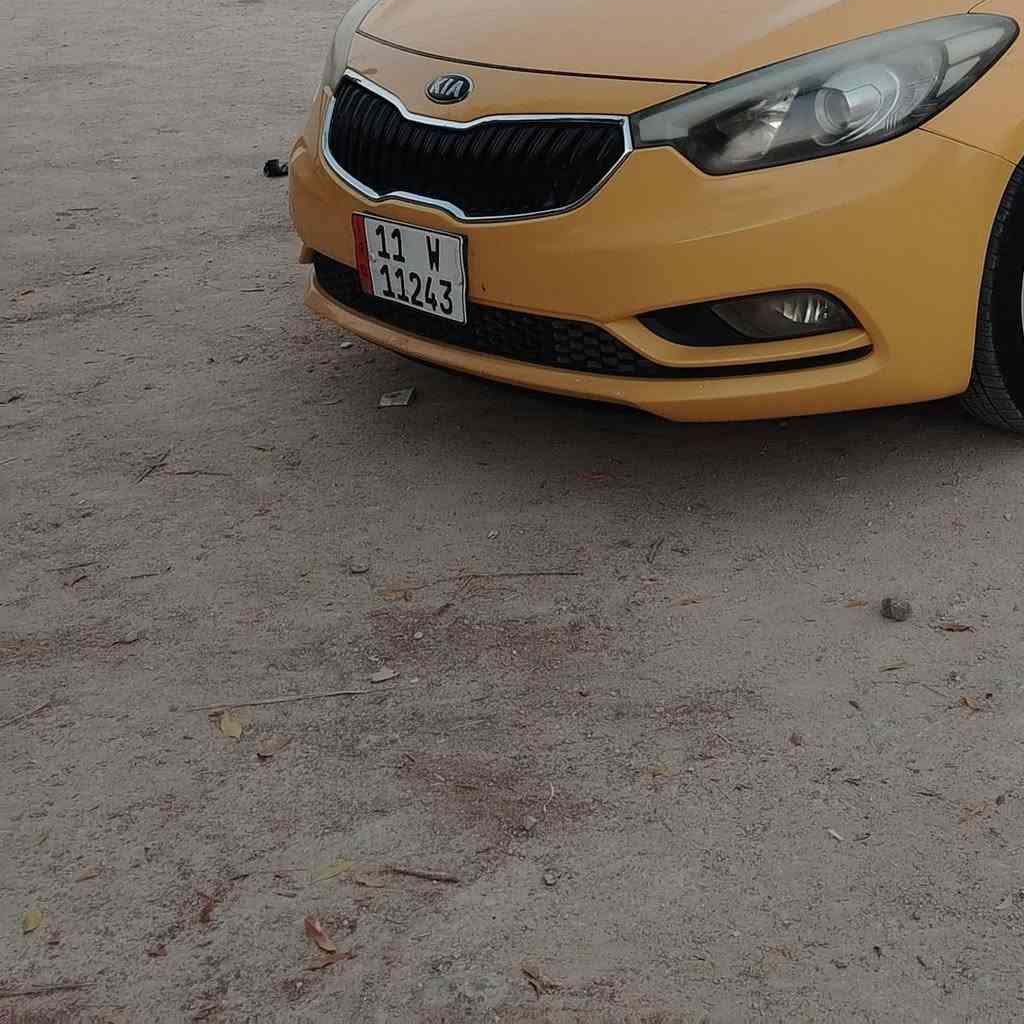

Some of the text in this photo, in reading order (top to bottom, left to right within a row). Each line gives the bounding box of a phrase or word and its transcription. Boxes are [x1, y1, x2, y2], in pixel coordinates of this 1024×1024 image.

[376, 224, 440, 272] 11 W
[380, 264, 453, 315] 11243
